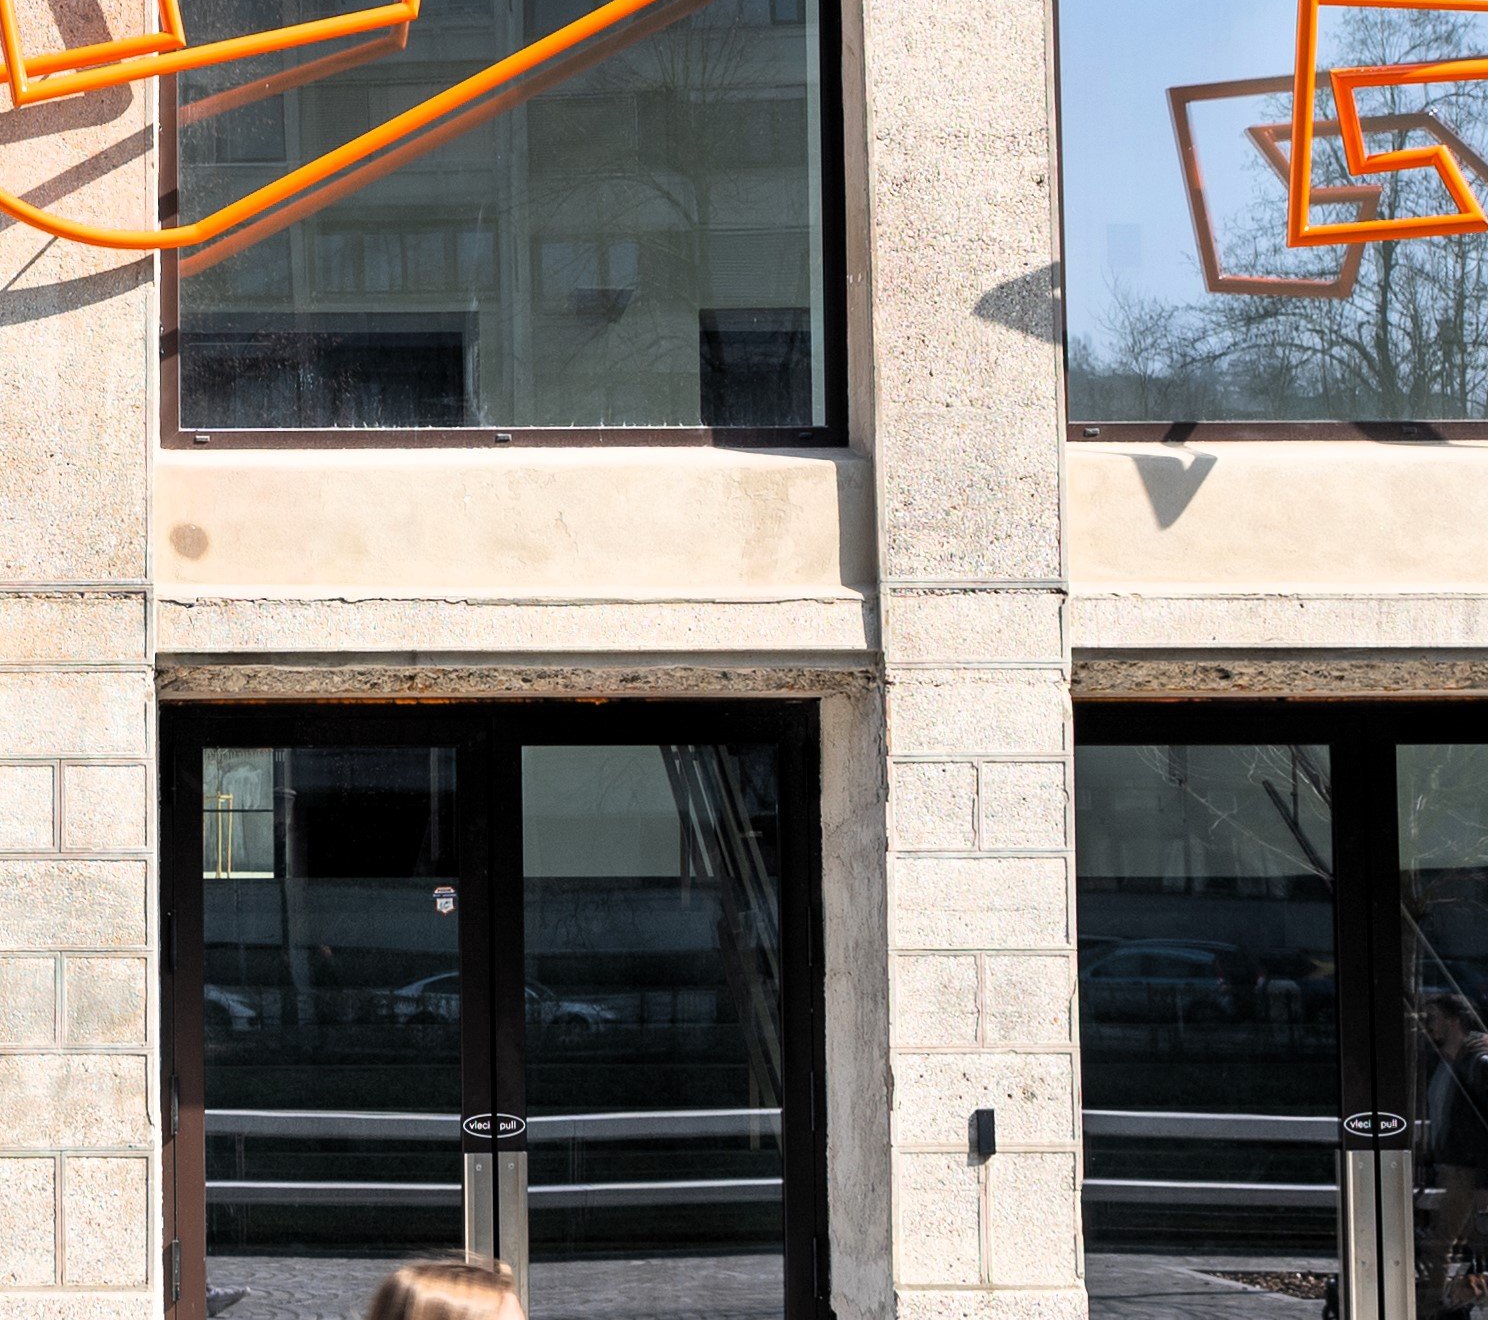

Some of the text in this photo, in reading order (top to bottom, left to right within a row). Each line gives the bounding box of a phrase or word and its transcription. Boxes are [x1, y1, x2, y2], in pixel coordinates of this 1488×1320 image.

[469, 1120, 517, 1131] vleci pull
[1349, 1119, 1398, 1130] vleci pull
